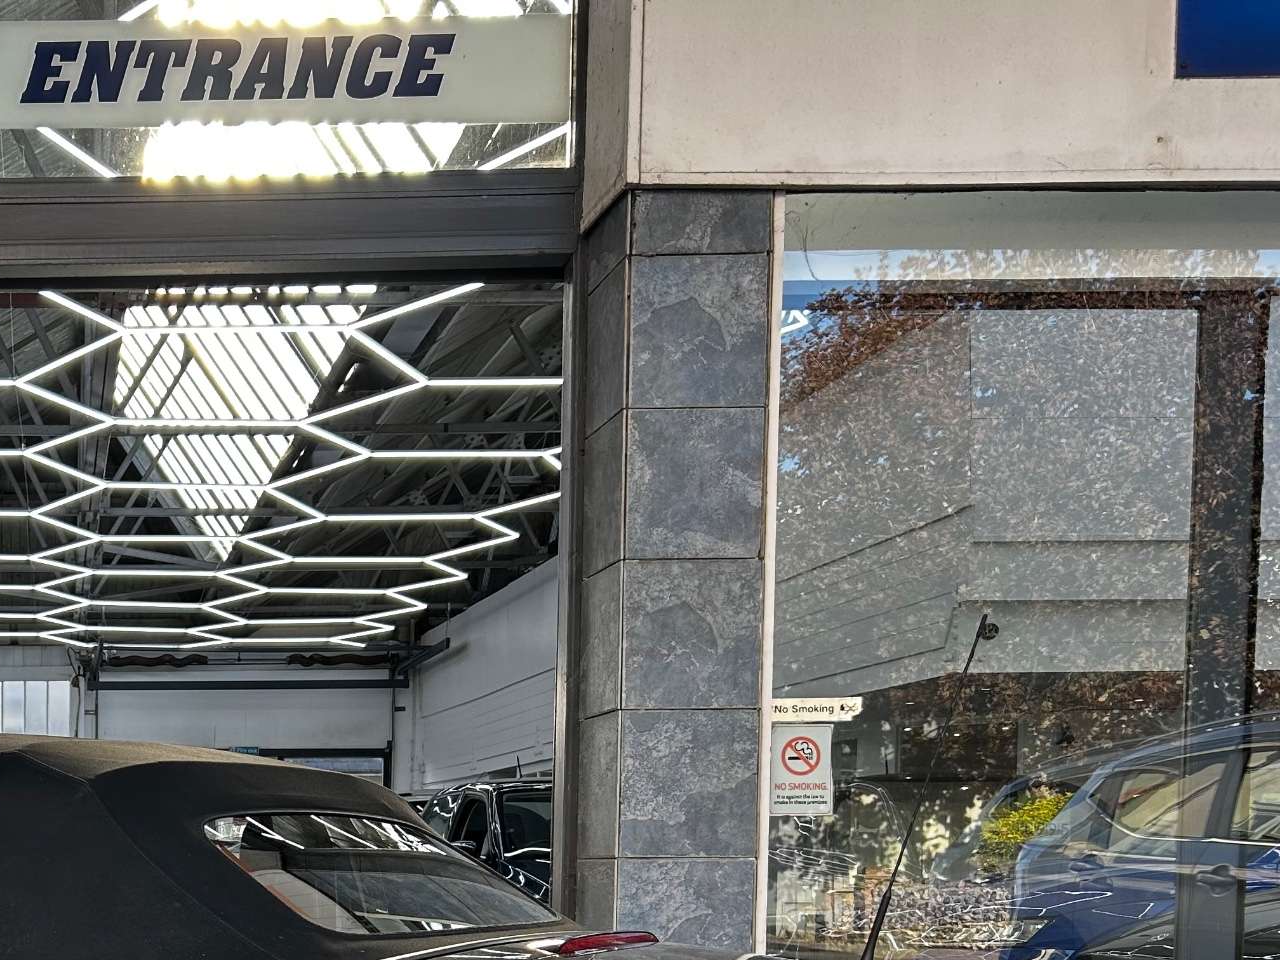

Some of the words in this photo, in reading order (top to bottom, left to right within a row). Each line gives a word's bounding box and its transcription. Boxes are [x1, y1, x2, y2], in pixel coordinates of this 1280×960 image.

[19, 32, 457, 104] ENTRANCE
[774, 705, 789, 714] No
[791, 704, 835, 715] Smoking
[774, 782, 787, 791] NO
[788, 782, 827, 791] SMOKING
